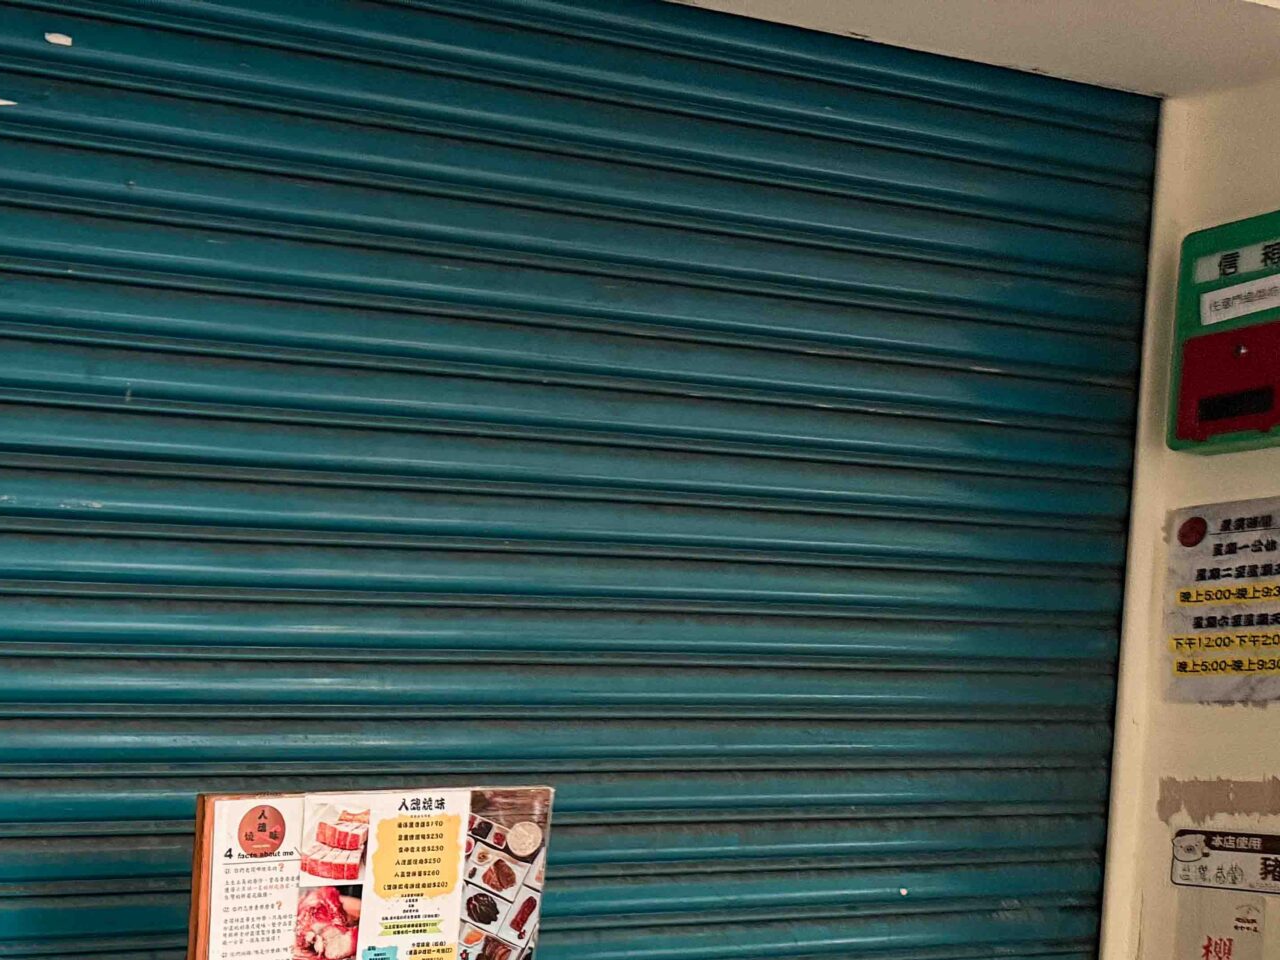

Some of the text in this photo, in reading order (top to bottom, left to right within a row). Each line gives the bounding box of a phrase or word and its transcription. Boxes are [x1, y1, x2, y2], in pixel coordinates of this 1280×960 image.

[1211, 834, 1262, 849] 本店使用
[224, 848, 233, 859] 4
